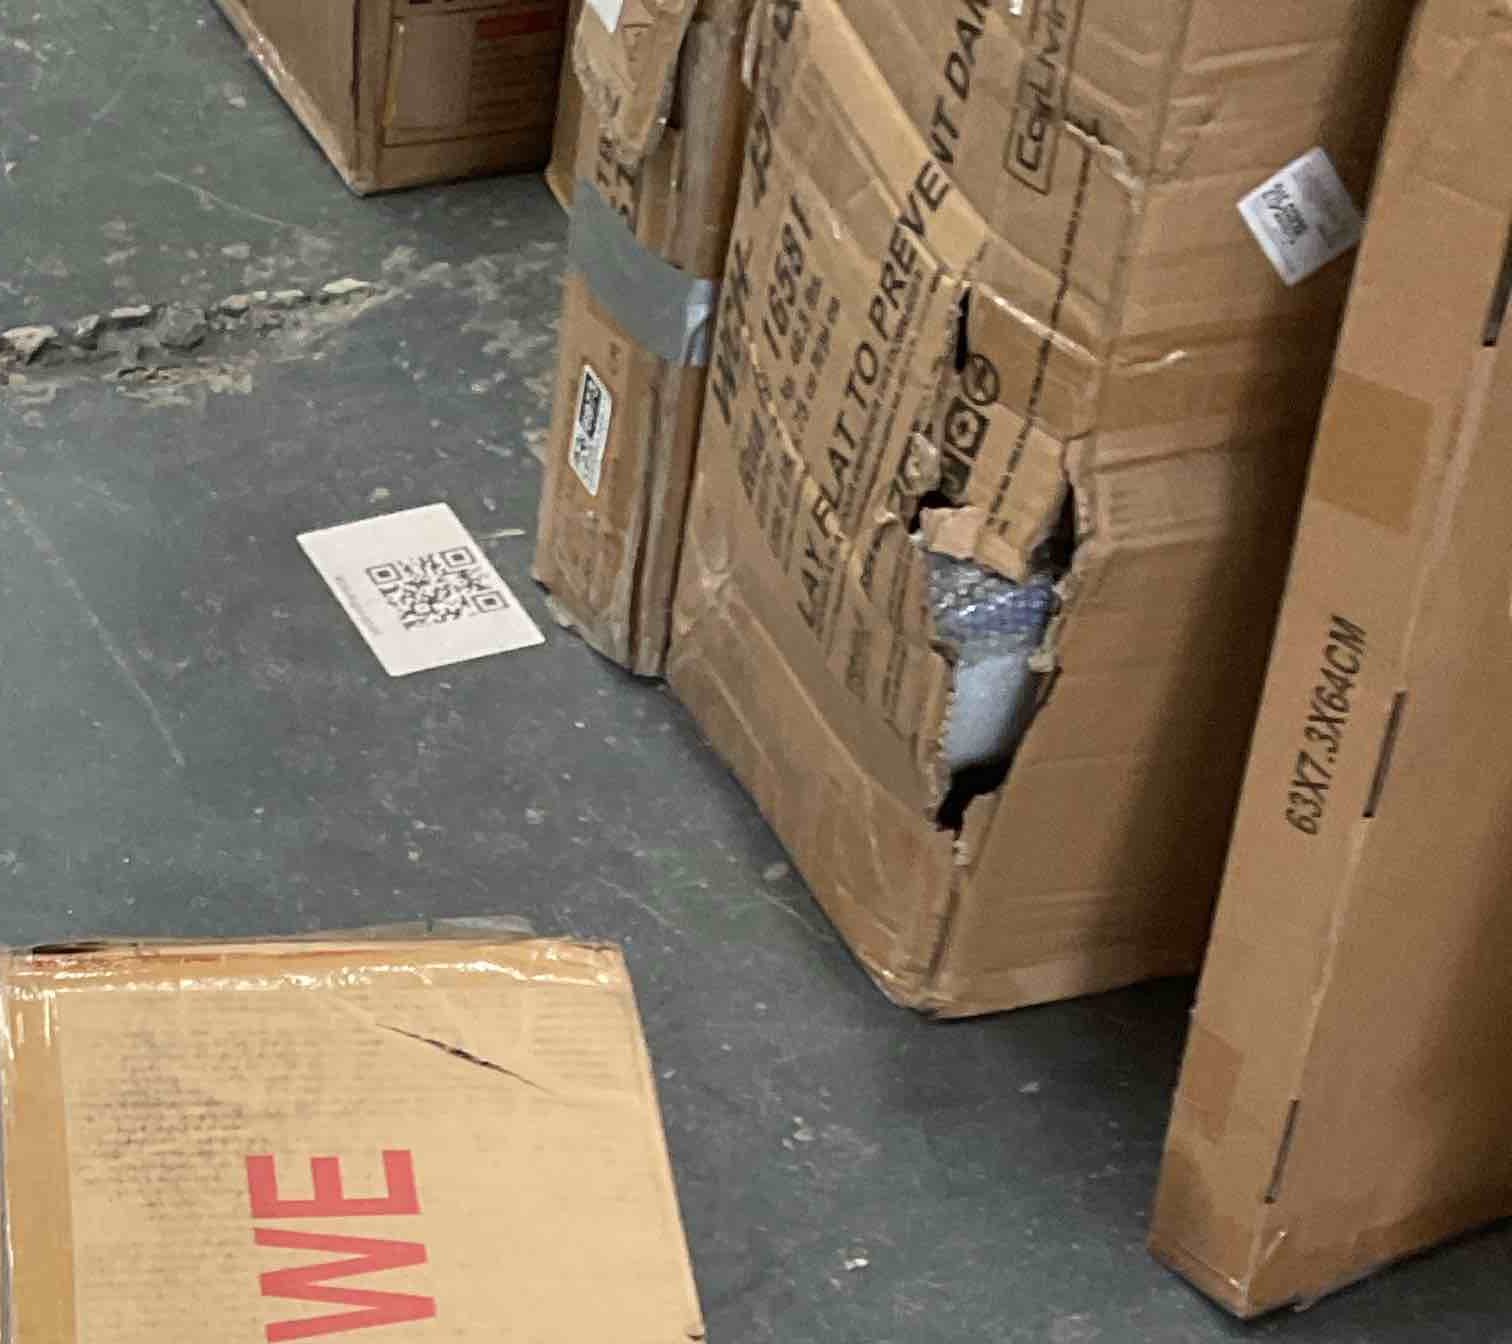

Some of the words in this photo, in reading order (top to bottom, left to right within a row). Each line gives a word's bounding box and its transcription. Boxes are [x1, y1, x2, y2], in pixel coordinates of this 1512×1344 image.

[810, 410, 856, 539] FLAT
[845, 341, 879, 409] TO
[869, 95, 960, 341] PREVENT
[1285, 613, 1366, 835] 63X7.3X64CM
